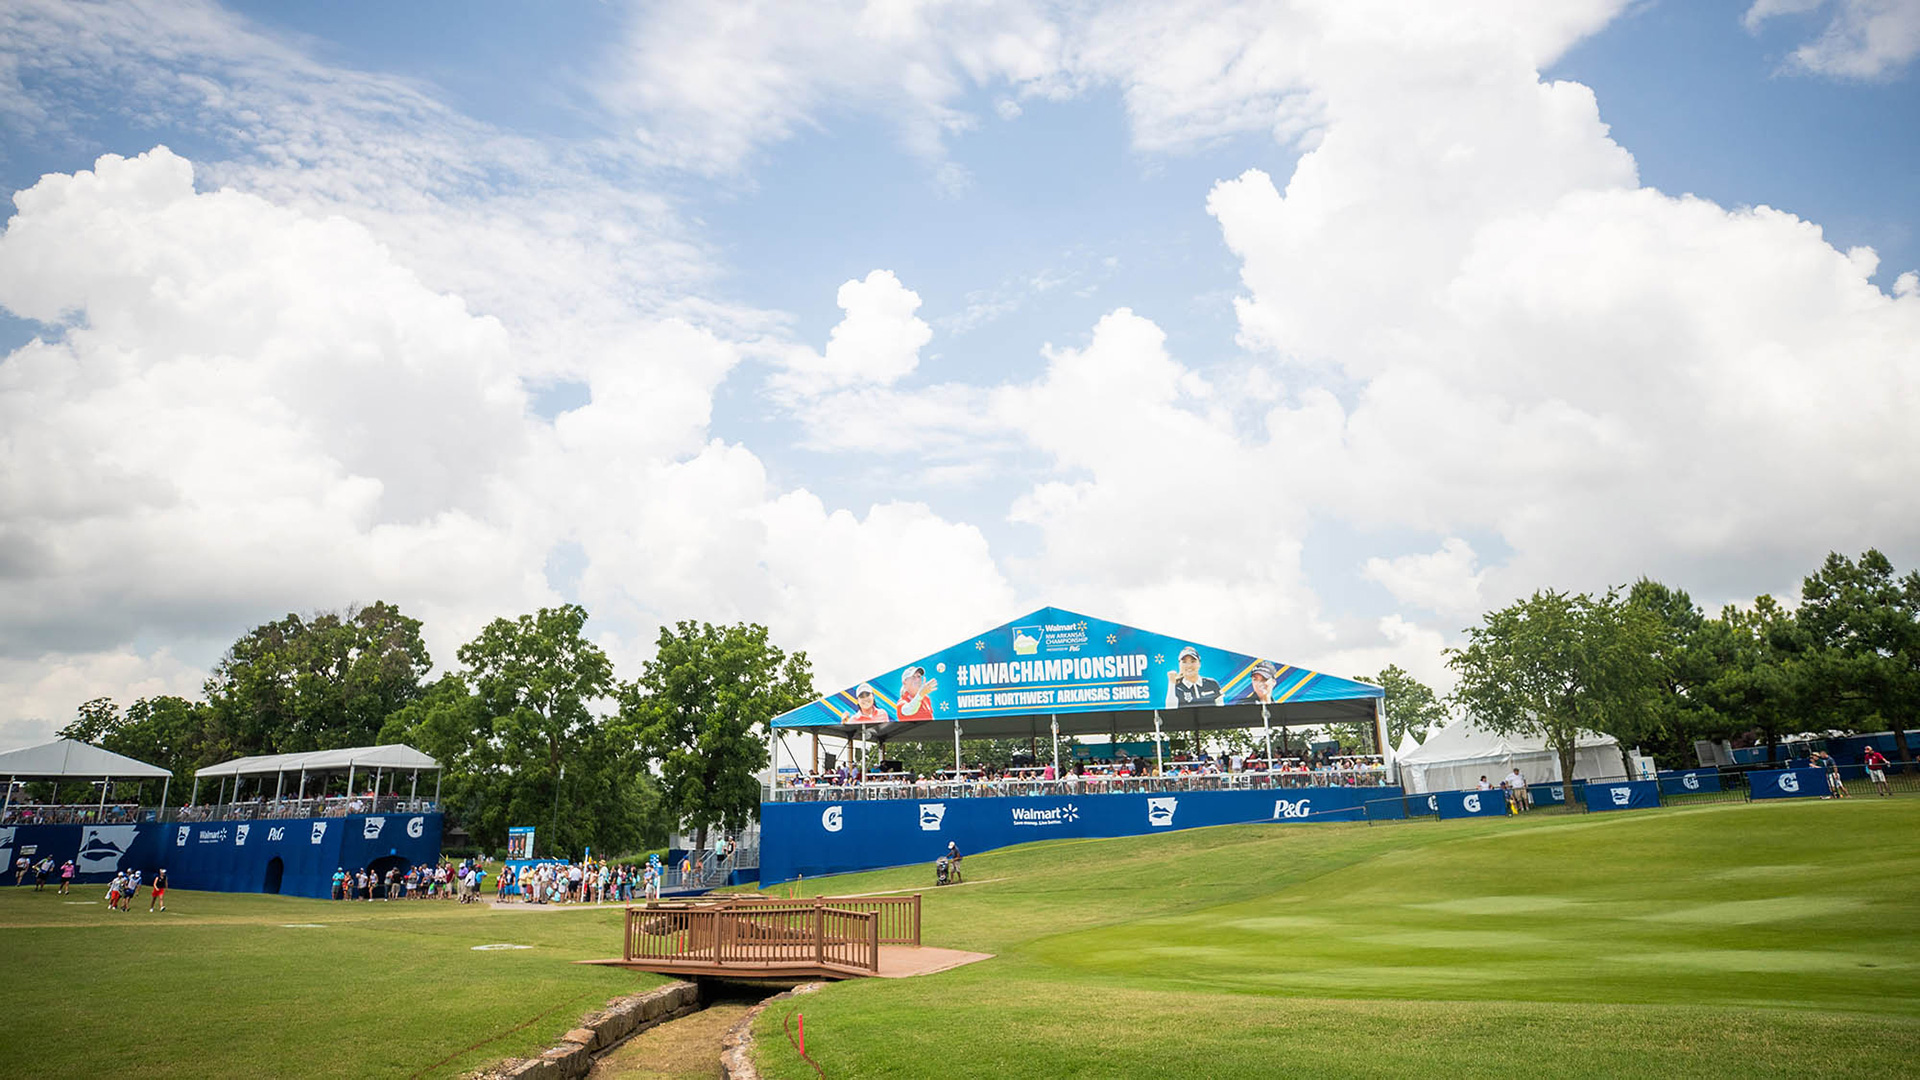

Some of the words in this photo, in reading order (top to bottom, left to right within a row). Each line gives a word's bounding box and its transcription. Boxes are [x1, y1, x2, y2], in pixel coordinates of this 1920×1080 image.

[1045, 623, 1077, 632] Walmart
[1045, 637, 1089, 645] CHAMPIONSHIP
[1056, 631, 1086, 639] ARKANSAS
[957, 654, 1148, 686] #NWACHAMPIONSHIP
[957, 694, 993, 708] WHERE
[994, 690, 1055, 706] NORTHWEST
[1057, 688, 1111, 703] ARKANSAS
[1112, 686, 1150, 700] SHINES
[1011, 807, 1062, 820] Walmart
[1273, 799, 1310, 819] P&G
[267, 827, 285, 841] P&G
